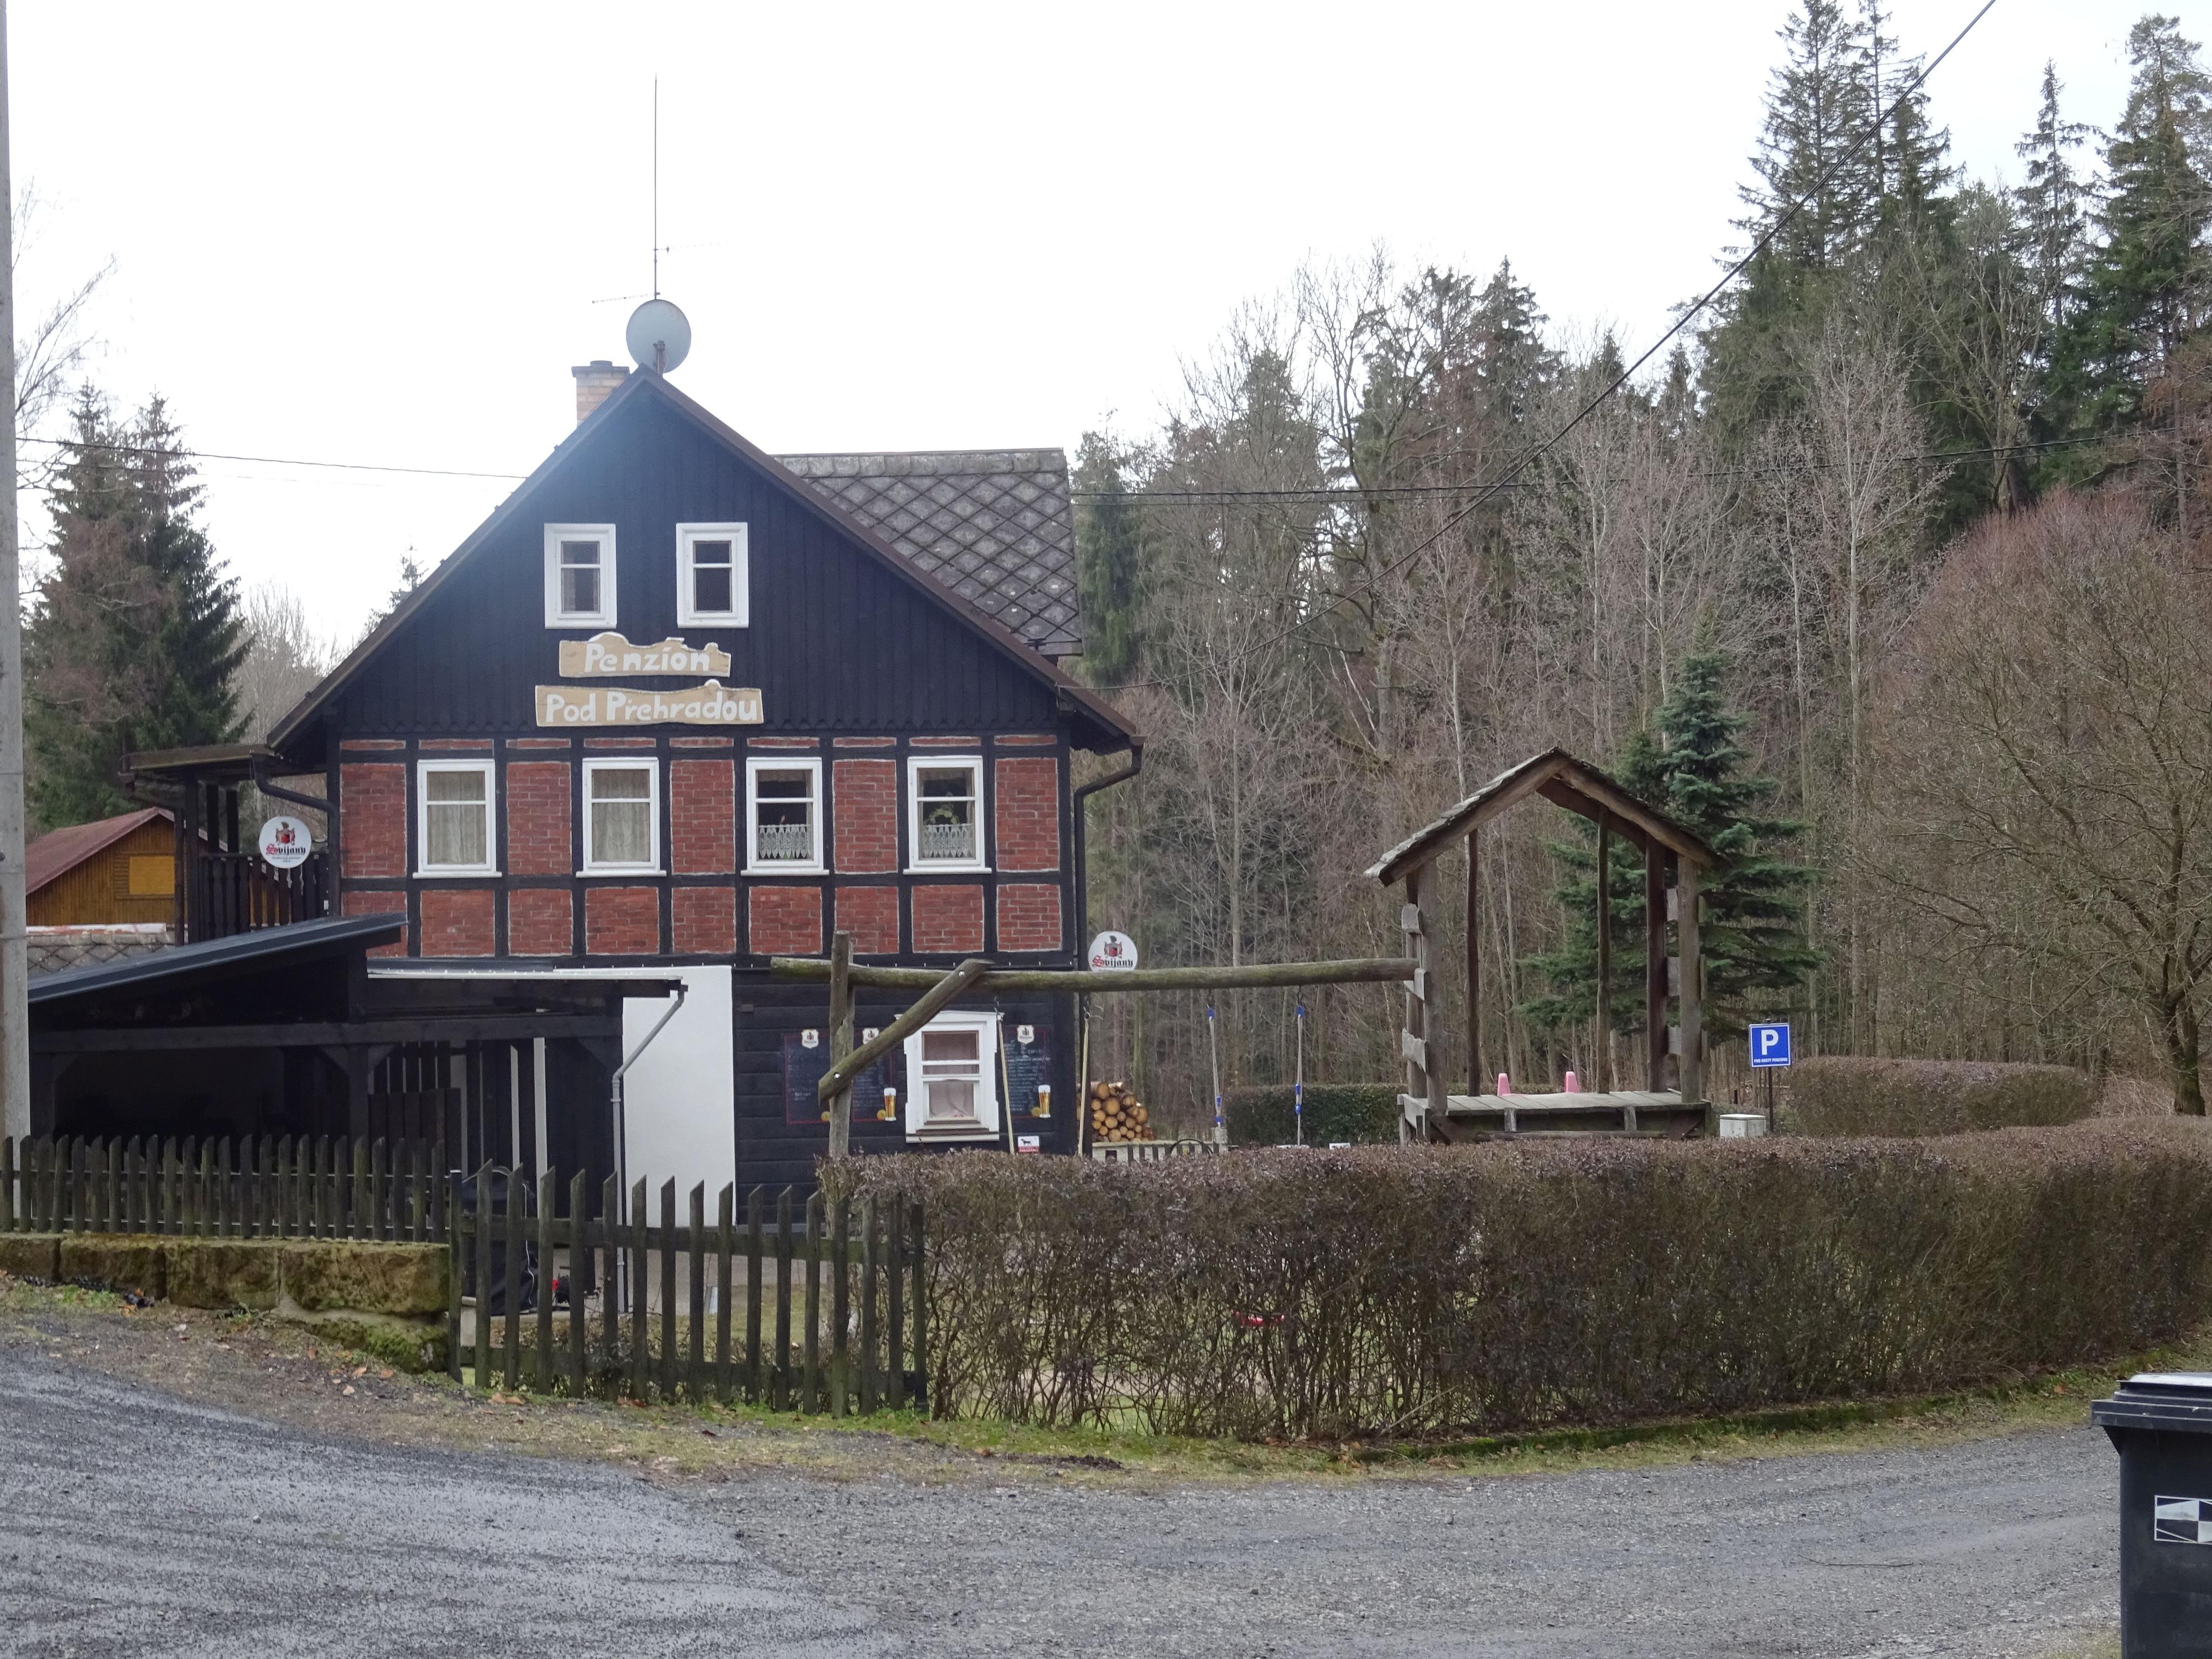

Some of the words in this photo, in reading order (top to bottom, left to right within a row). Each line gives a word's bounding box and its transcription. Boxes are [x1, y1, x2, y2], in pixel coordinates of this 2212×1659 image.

[546, 692, 596, 722] Pod
[266, 843, 306, 855] Svijany
[1092, 955, 1133, 968] Svijany
[1761, 1029, 1779, 1056] P
